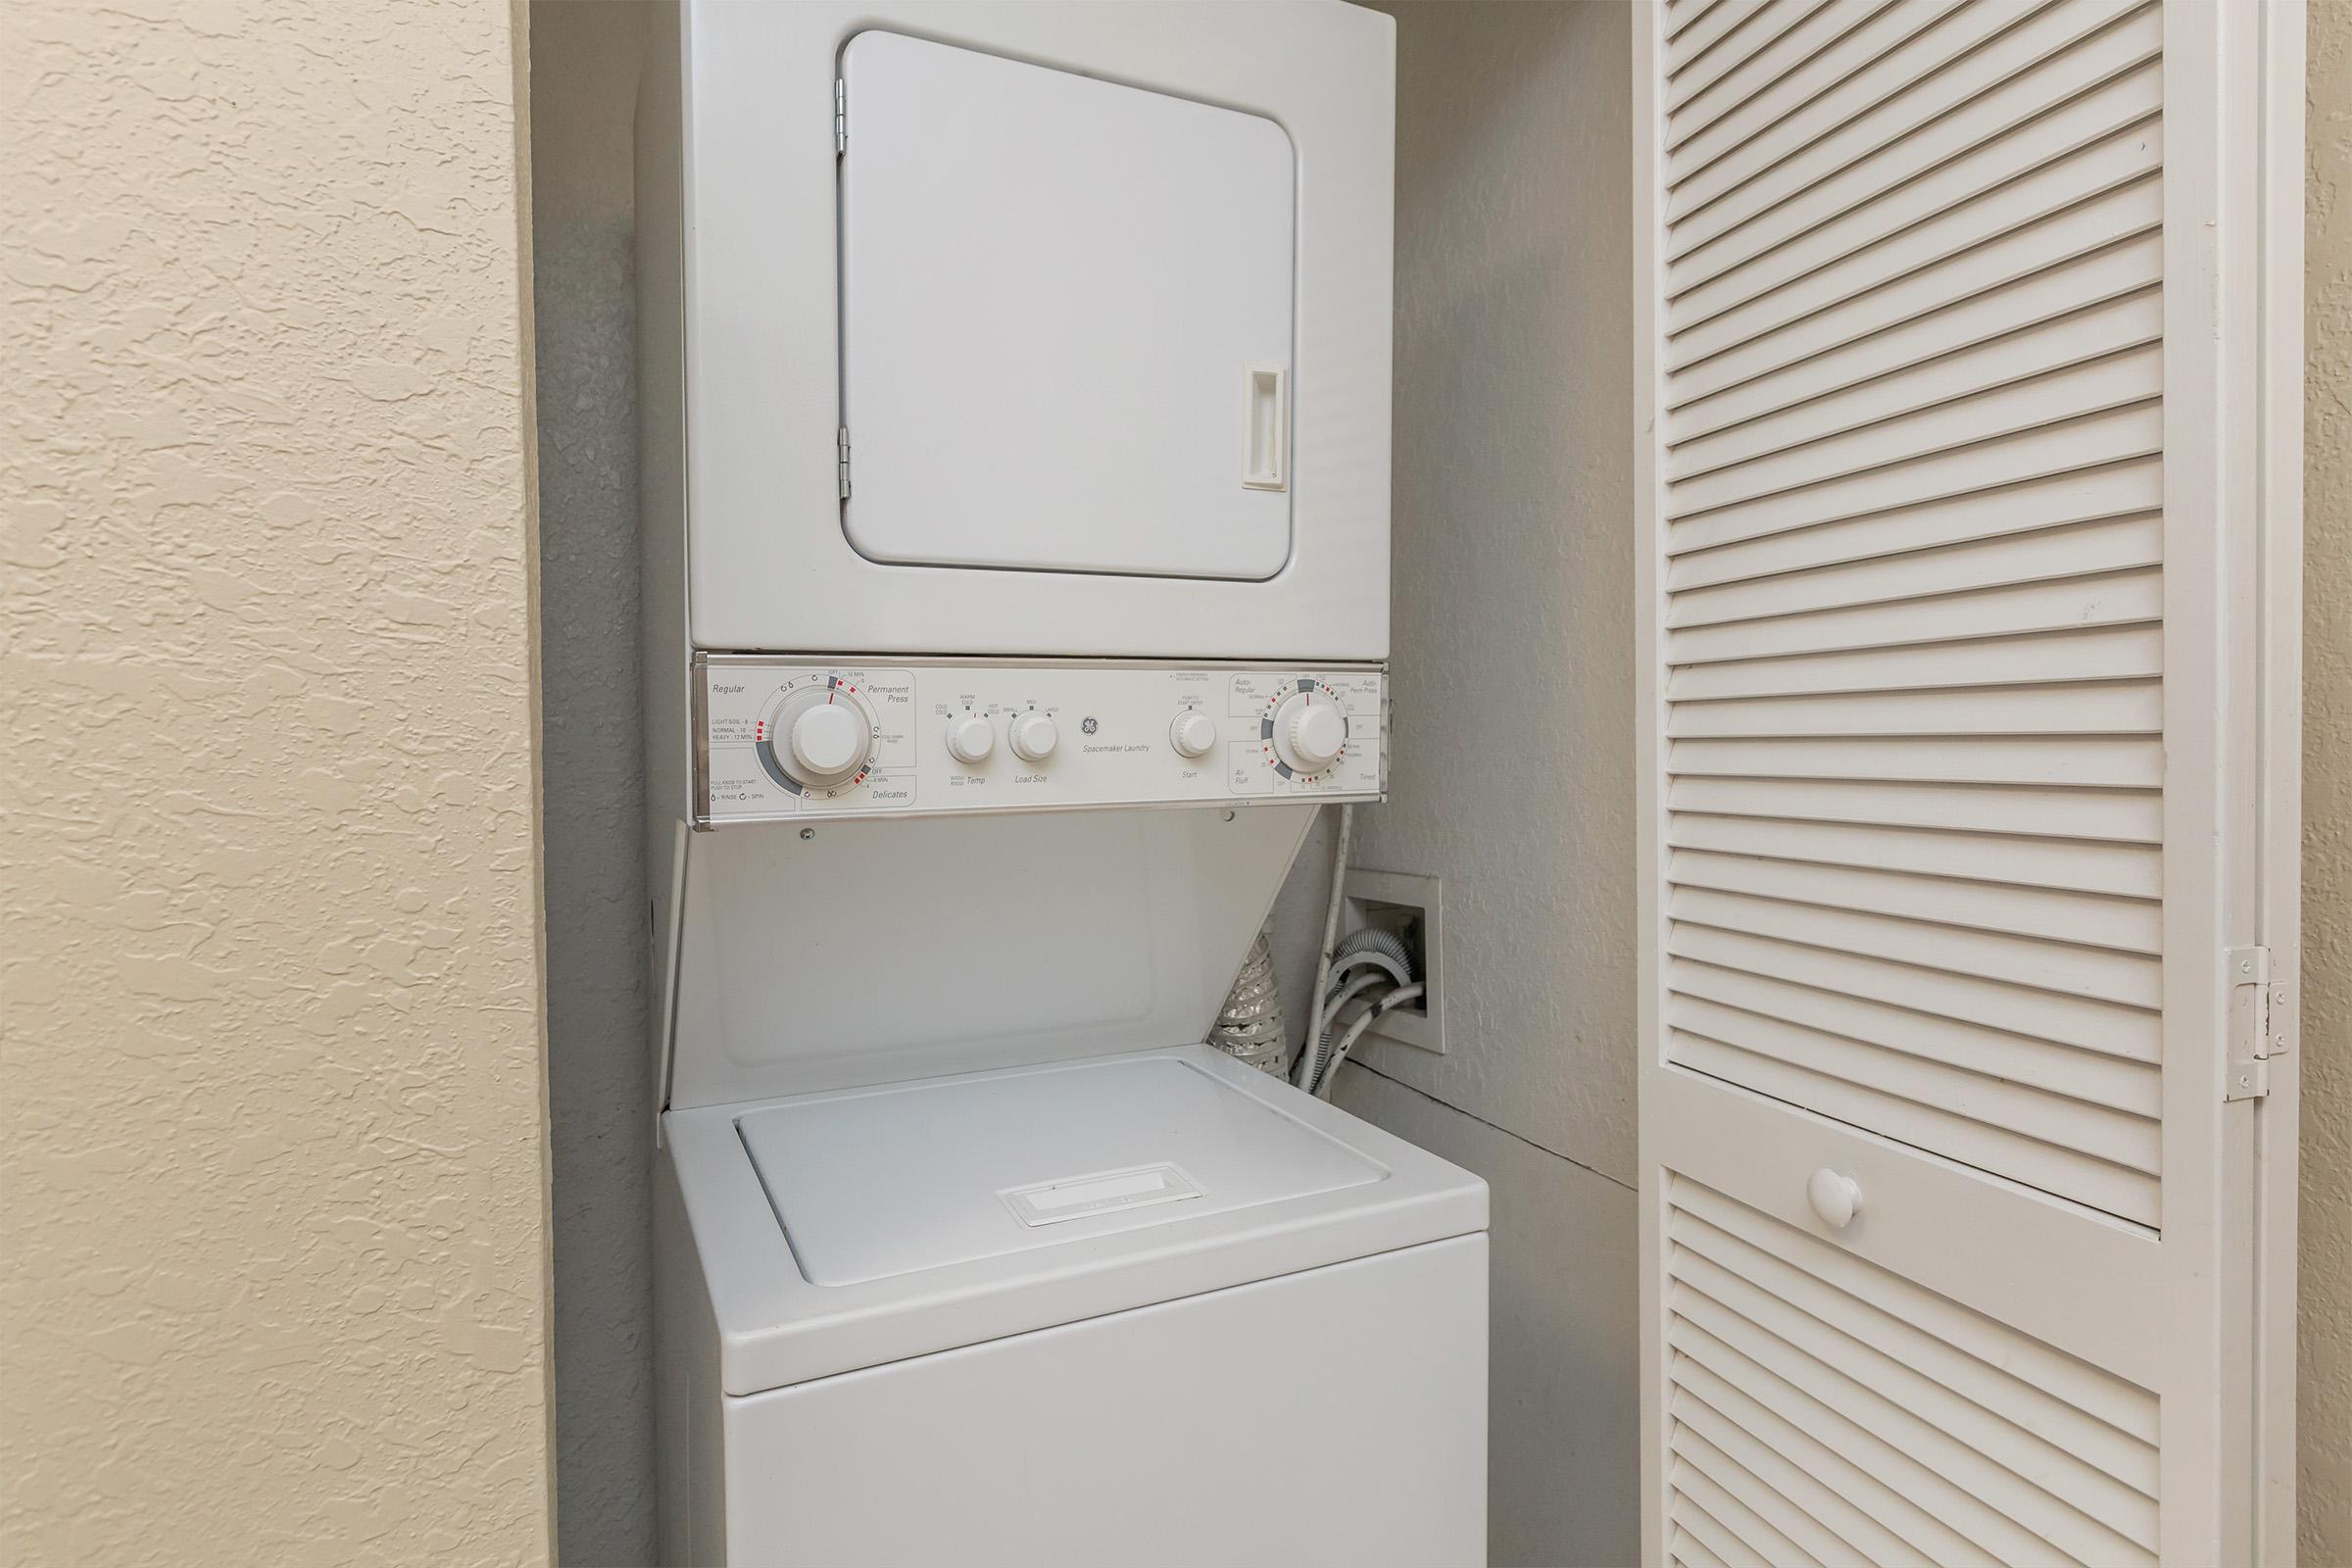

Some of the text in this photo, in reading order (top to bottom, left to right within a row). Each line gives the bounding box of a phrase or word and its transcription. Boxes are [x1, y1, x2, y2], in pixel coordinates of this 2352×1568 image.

[712, 684, 745, 694] Regular
[867, 685, 908, 694] Permanent
[887, 694, 908, 703] Press
[966, 776, 986, 785] Temp
[1015, 774, 1048, 784] Load Size
